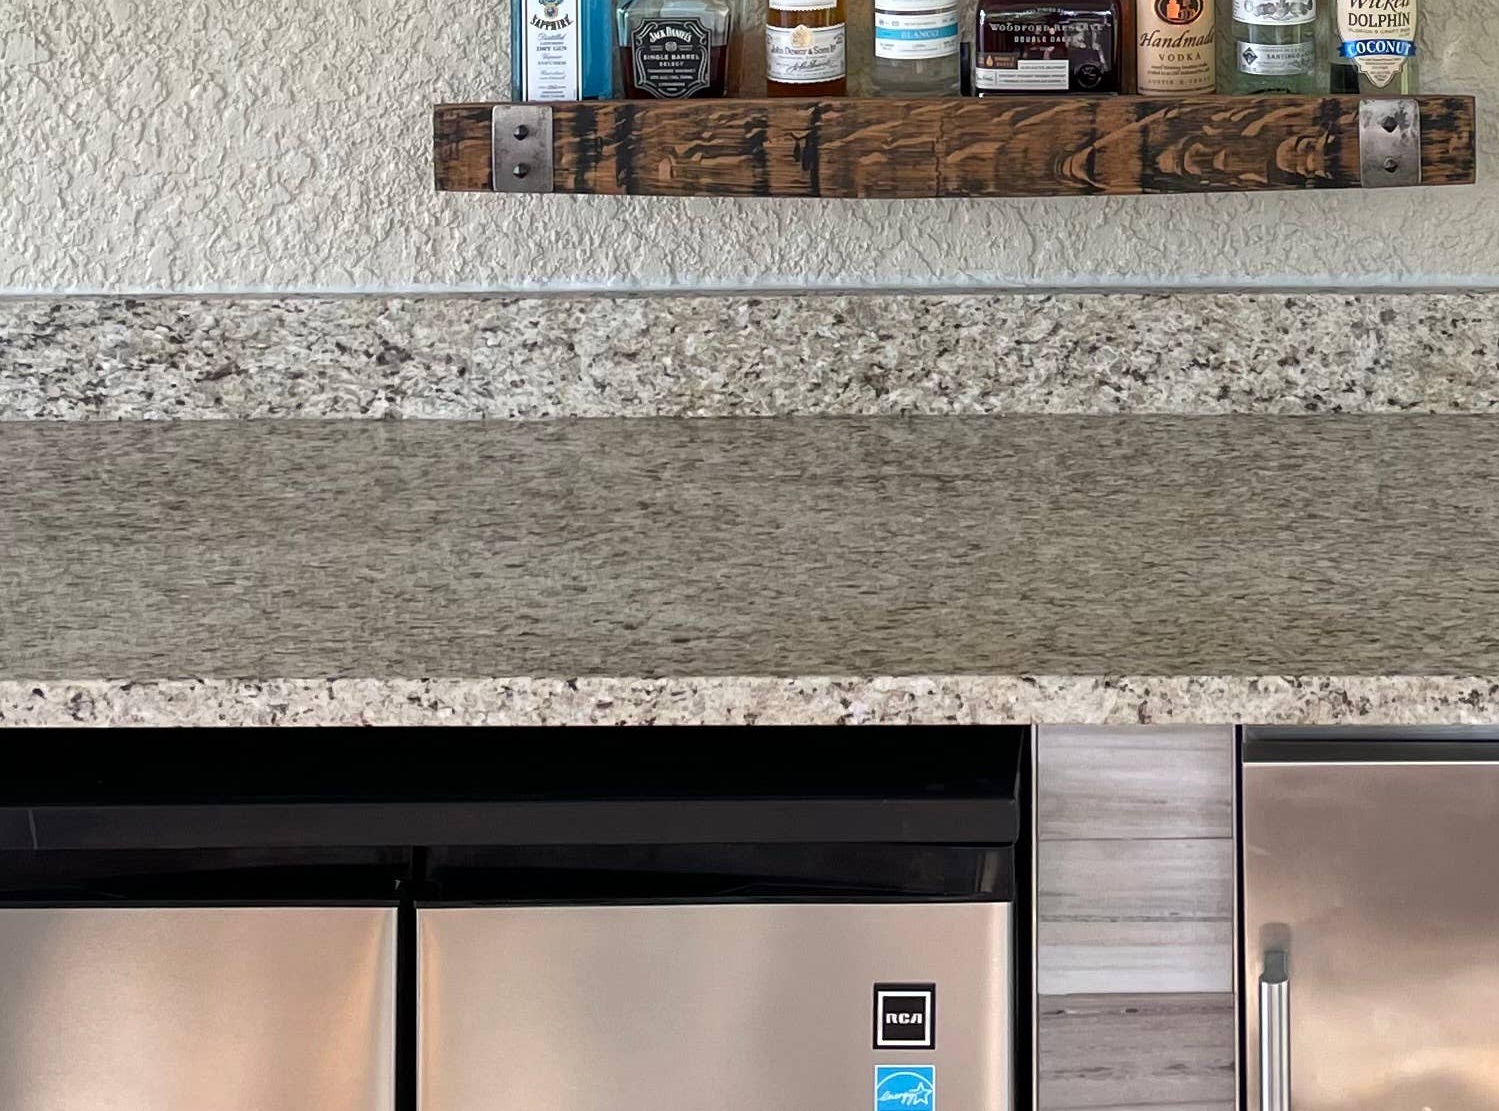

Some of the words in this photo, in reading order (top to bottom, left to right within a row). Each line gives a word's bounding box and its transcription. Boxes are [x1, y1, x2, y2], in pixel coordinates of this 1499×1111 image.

[530, 13, 574, 31] SAPPHIRE
[1348, 11, 1410, 27] DOLPHIN
[988, 22, 1050, 32] WOODFORD
[1346, 40, 1411, 55] COCONUT
[1158, 52, 1202, 62] VODKA
[885, 1012, 923, 1025] RCA
